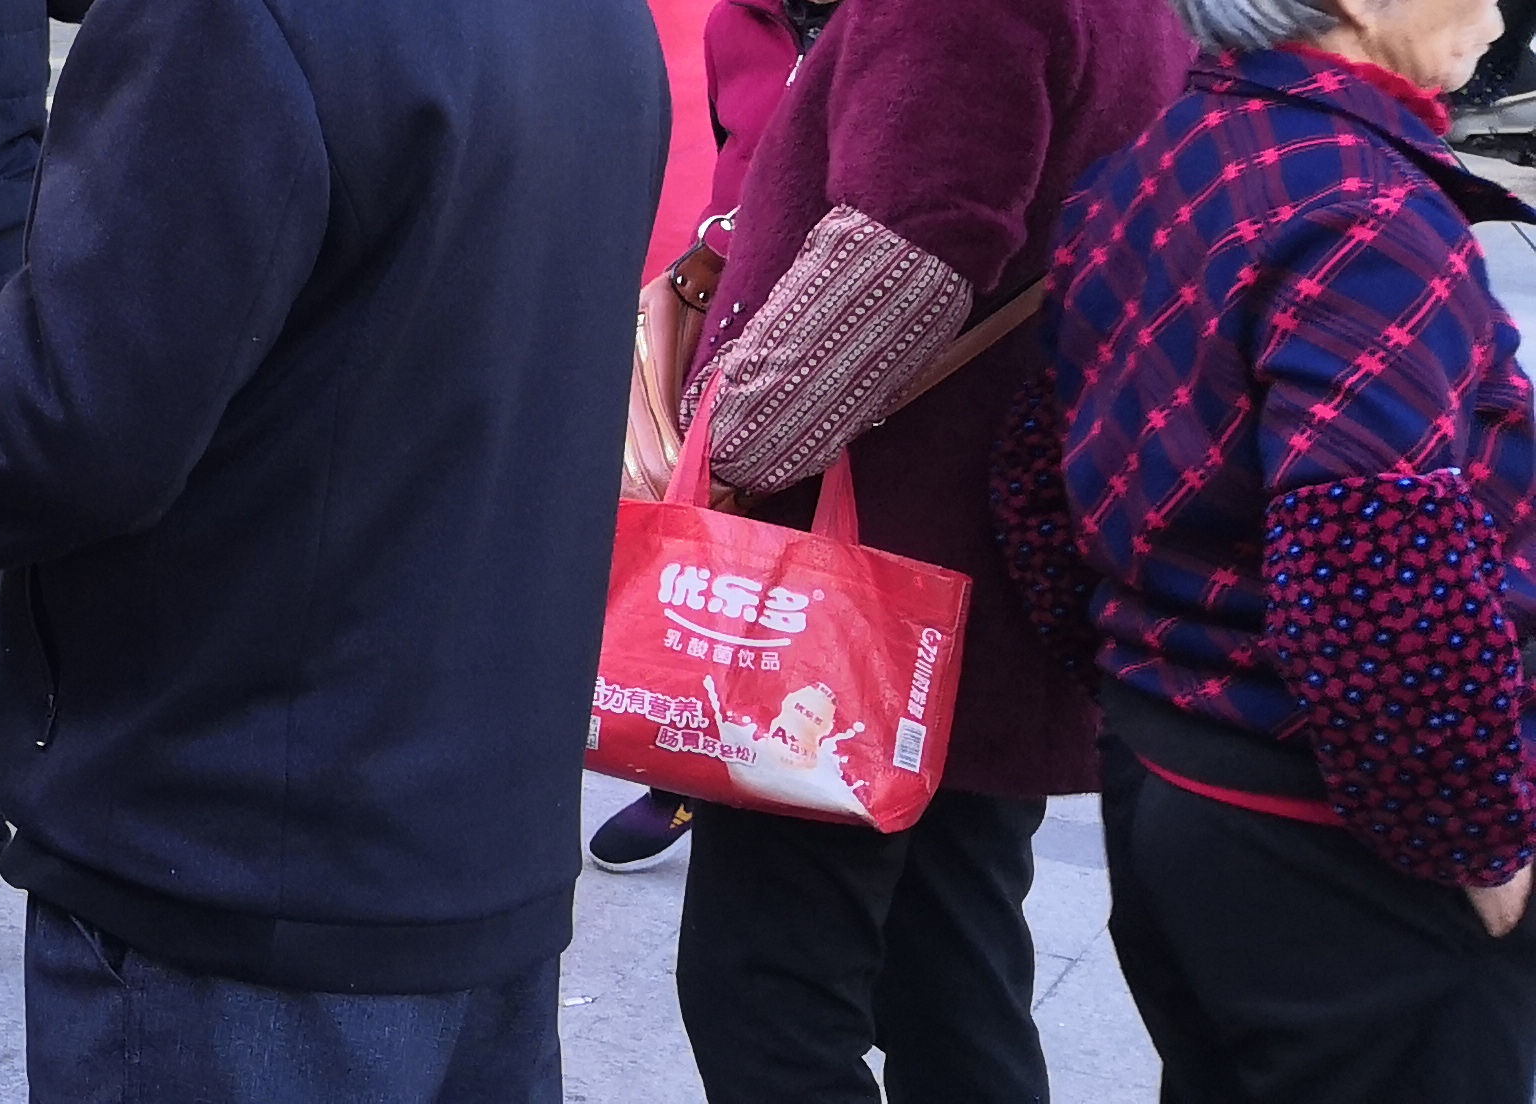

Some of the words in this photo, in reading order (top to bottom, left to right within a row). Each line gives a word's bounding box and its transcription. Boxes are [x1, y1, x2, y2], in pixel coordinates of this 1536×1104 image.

[658, 563, 809, 633] 优乐多
[664, 629, 780, 671] 乳酸菌饮品
